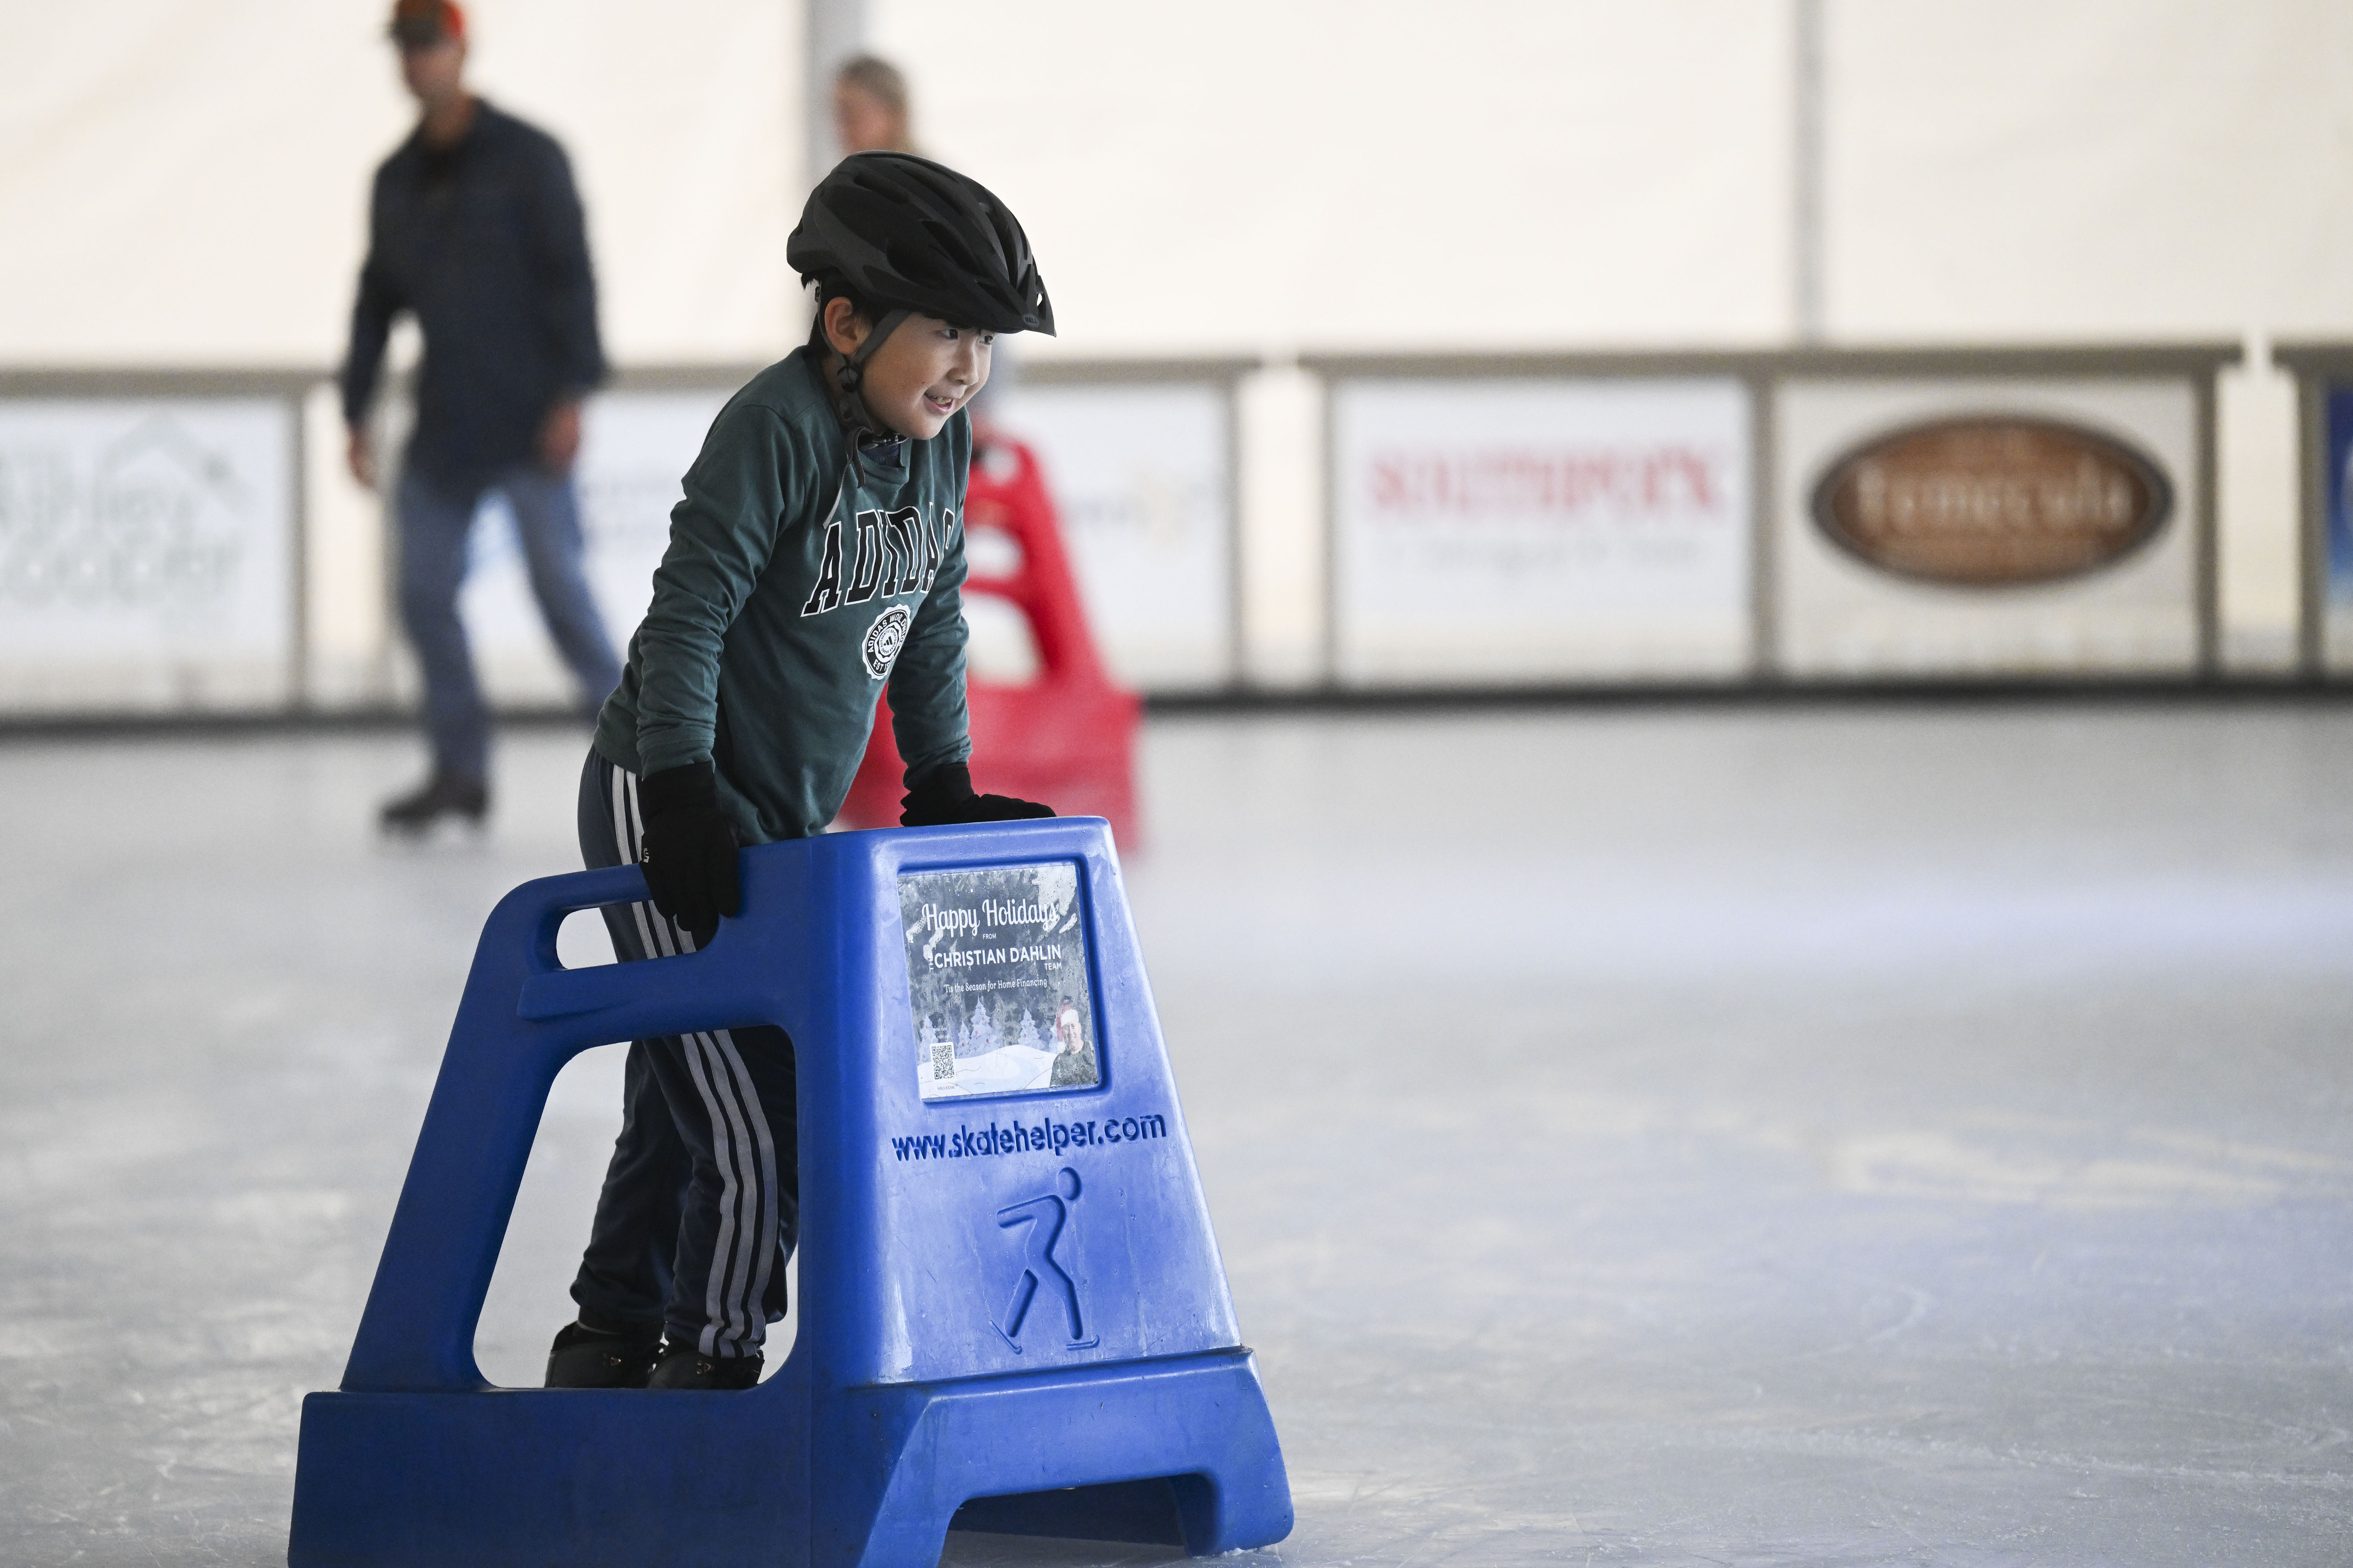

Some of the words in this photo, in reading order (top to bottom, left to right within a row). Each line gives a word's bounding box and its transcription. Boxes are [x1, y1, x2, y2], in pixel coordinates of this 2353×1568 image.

[868, 619, 887, 653] ADIDAS
[889, 613, 906, 646] WOLDWID
[873, 659, 884, 672] EST
[921, 903, 981, 938] Happy
[982, 898, 1060, 932] Holidays
[934, 948, 1006, 969] CHRISTIAN
[1009, 944, 1061, 963] DAHLIN
[1044, 962, 1062, 970] TEAM
[954, 983, 964, 993] the
[965, 982, 986, 992] Season
[987, 980, 997, 993] for
[998, 979, 1016, 989] Home
[1016, 977, 1048, 989] Financing
[891, 1114, 1167, 1162] www.skatehelper.com
